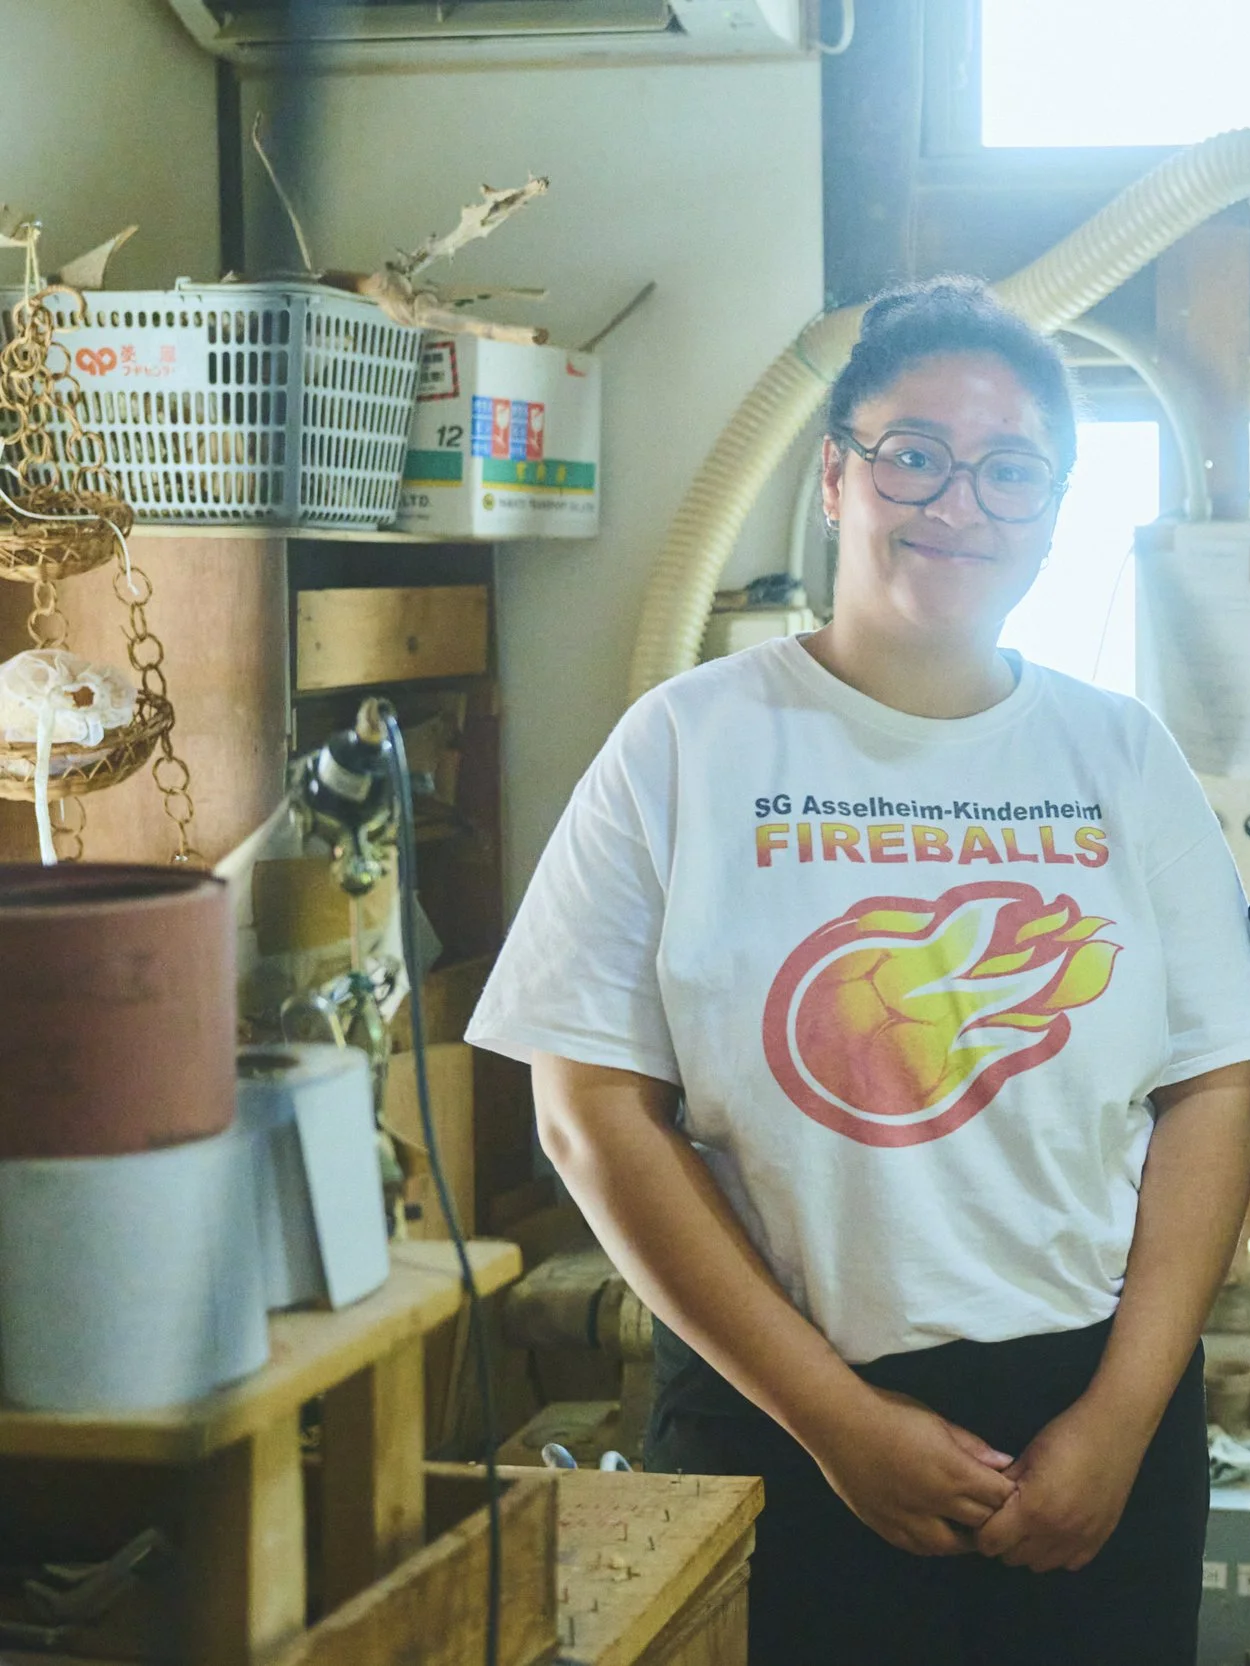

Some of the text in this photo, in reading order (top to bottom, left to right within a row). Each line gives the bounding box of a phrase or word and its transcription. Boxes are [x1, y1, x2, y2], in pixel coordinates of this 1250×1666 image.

[436, 425, 463, 447] 12
[755, 794, 1103, 821] SG Asselheim-Kindenheim
[755, 822, 1109, 868] FIREBALLS
